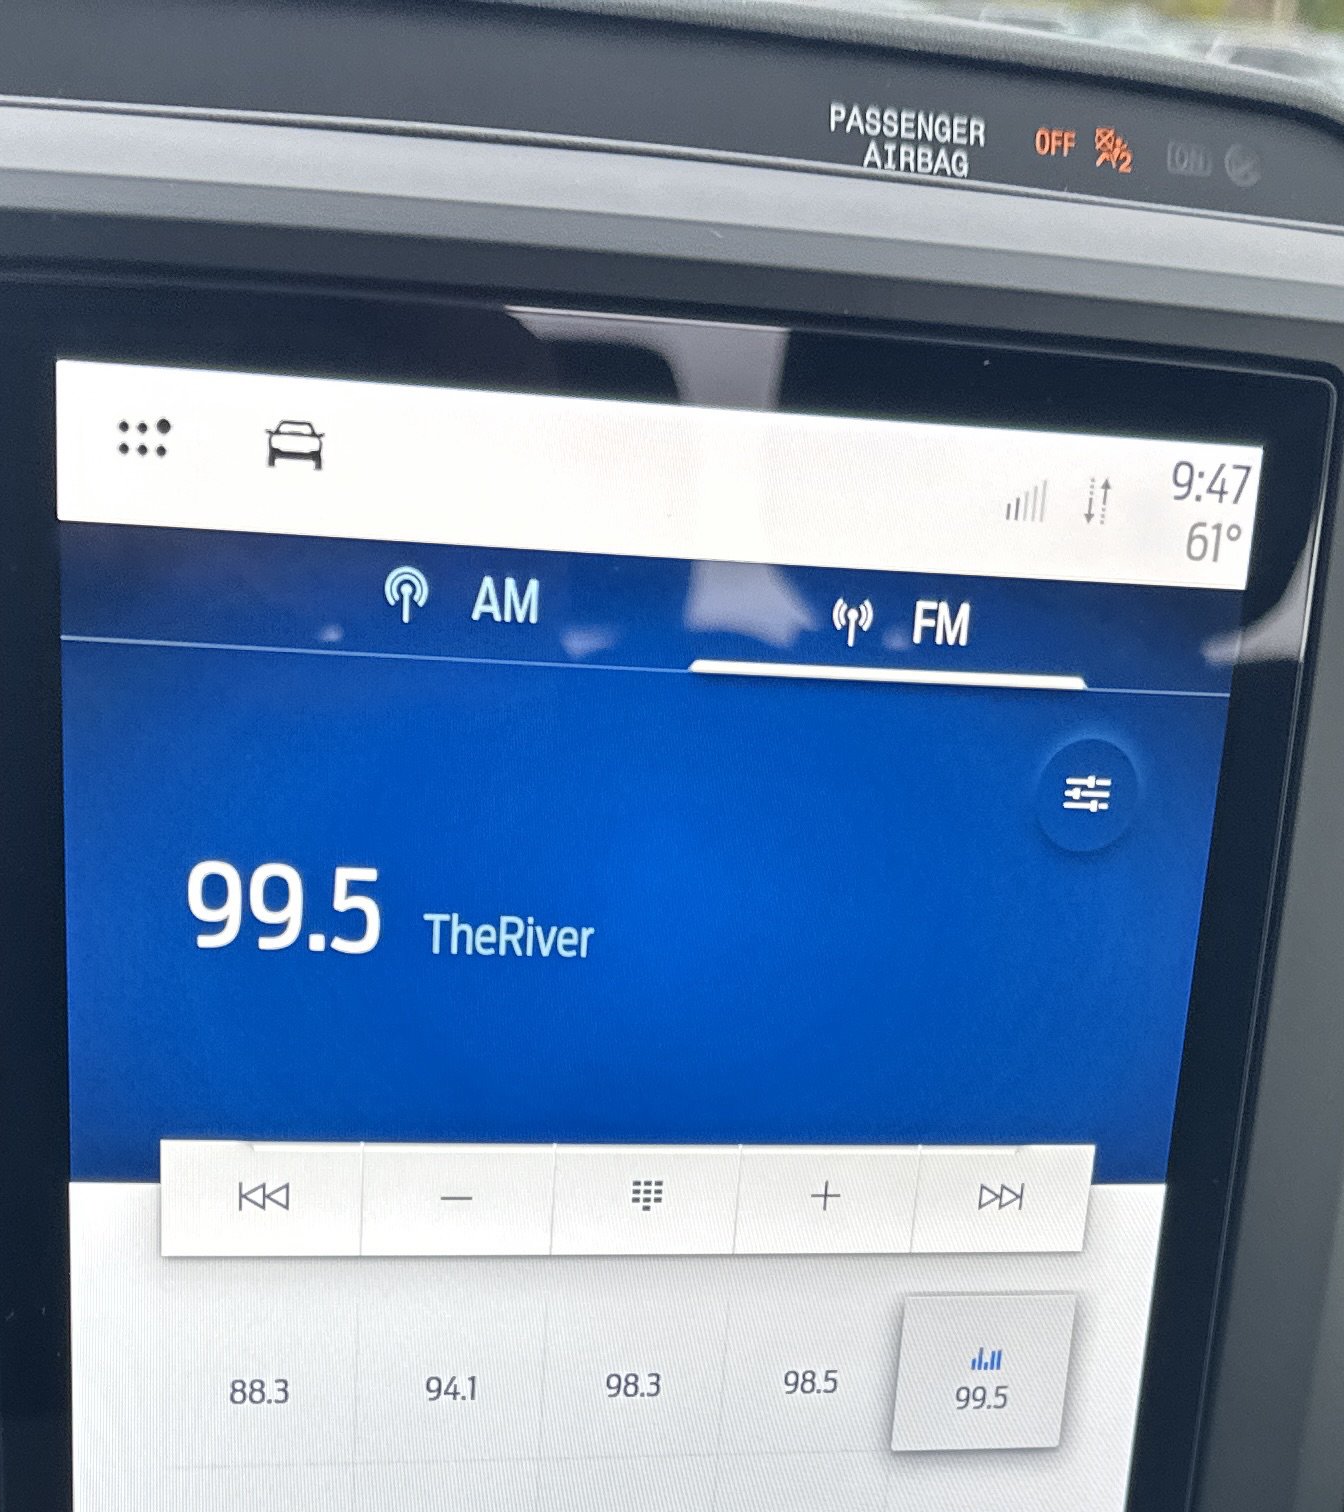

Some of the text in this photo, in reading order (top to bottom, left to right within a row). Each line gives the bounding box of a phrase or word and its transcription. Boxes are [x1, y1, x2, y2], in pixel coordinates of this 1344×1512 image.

[830, 101, 985, 147] PASSENGER
[1035, 126, 1076, 157] OFF
[863, 139, 969, 178] AIRBAG
[1172, 459, 1253, 505] 9:47
[1186, 521, 1242, 563] 61°
[471, 574, 541, 625] AM
[911, 599, 971, 648] FM
[187, 858, 596, 959] 99.5 TheRiver
[228, 1377, 291, 1406] 88.3
[424, 1374, 479, 1403] 94.1
[605, 1371, 662, 1399] 98.3
[782, 1368, 839, 1396] 98.5
[954, 1384, 1010, 1411] 99.5
